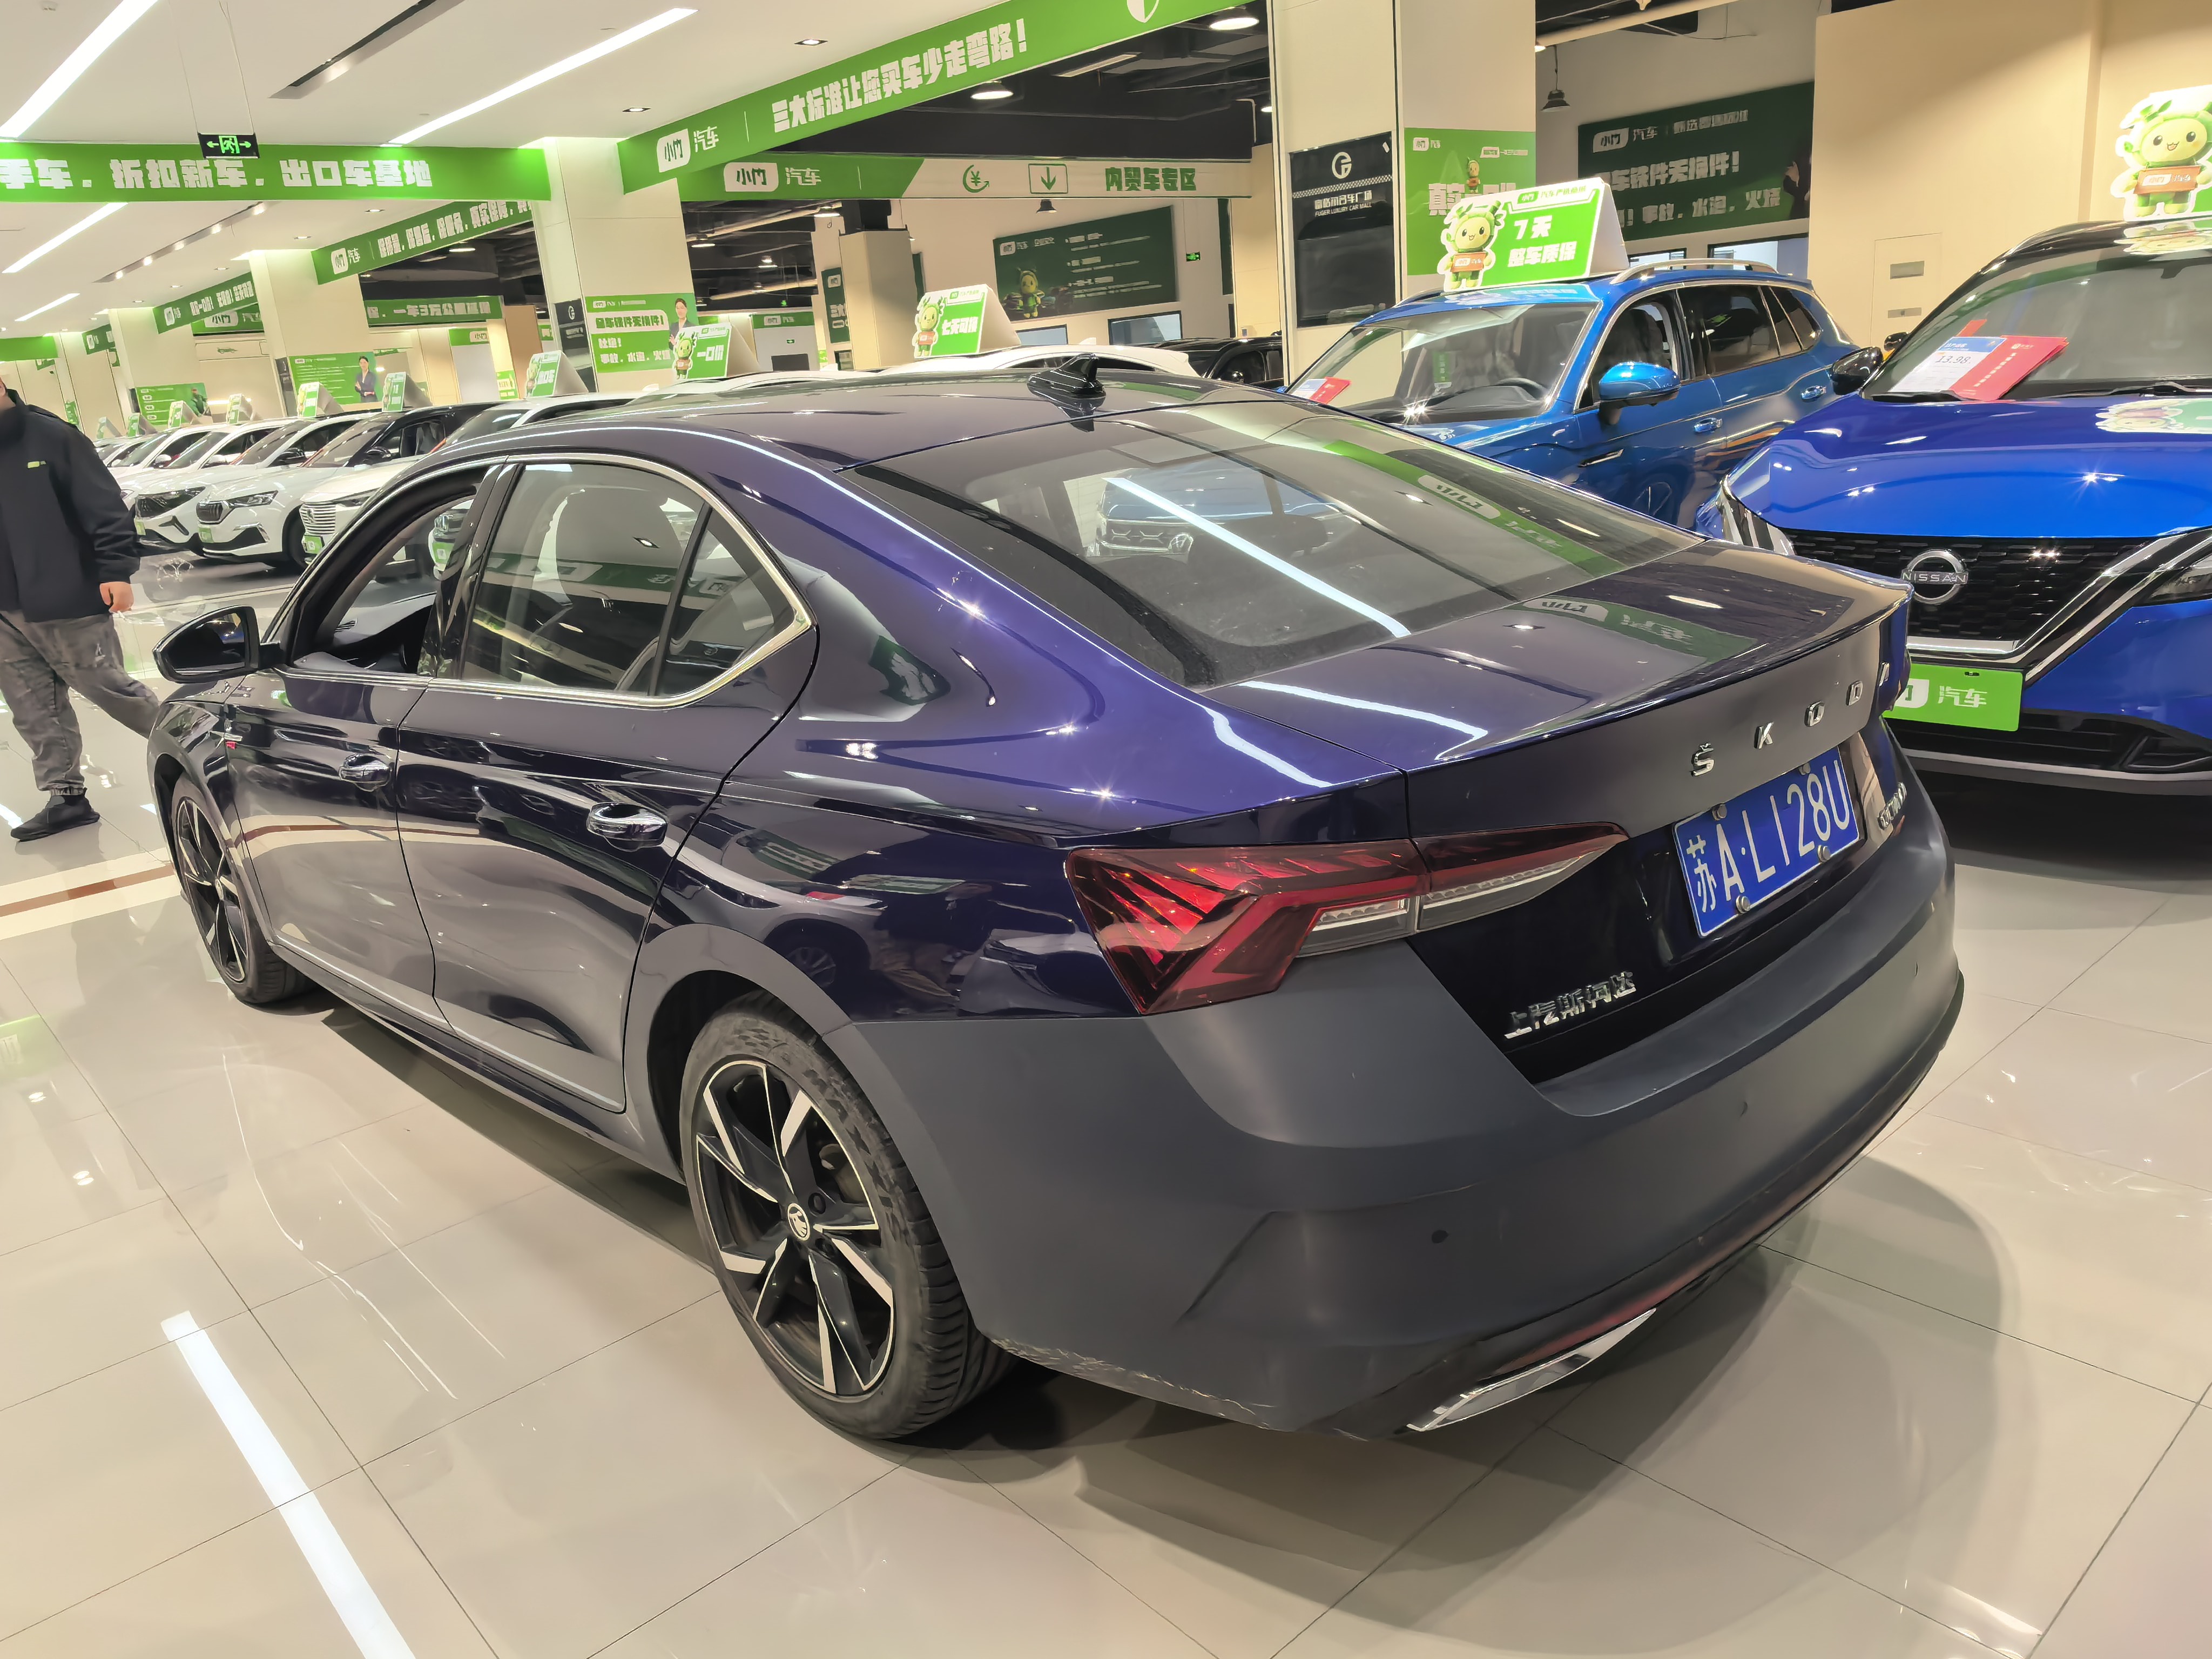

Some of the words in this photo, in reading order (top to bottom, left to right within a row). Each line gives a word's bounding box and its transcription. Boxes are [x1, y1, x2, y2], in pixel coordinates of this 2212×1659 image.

[693, 126, 719, 153] 汽车
[785, 167, 821, 186] 汽车
[1507, 241, 1577, 268] 整车质保
[1902, 571, 1966, 583] NISSAN
[1938, 685, 1988, 708] 汽车
